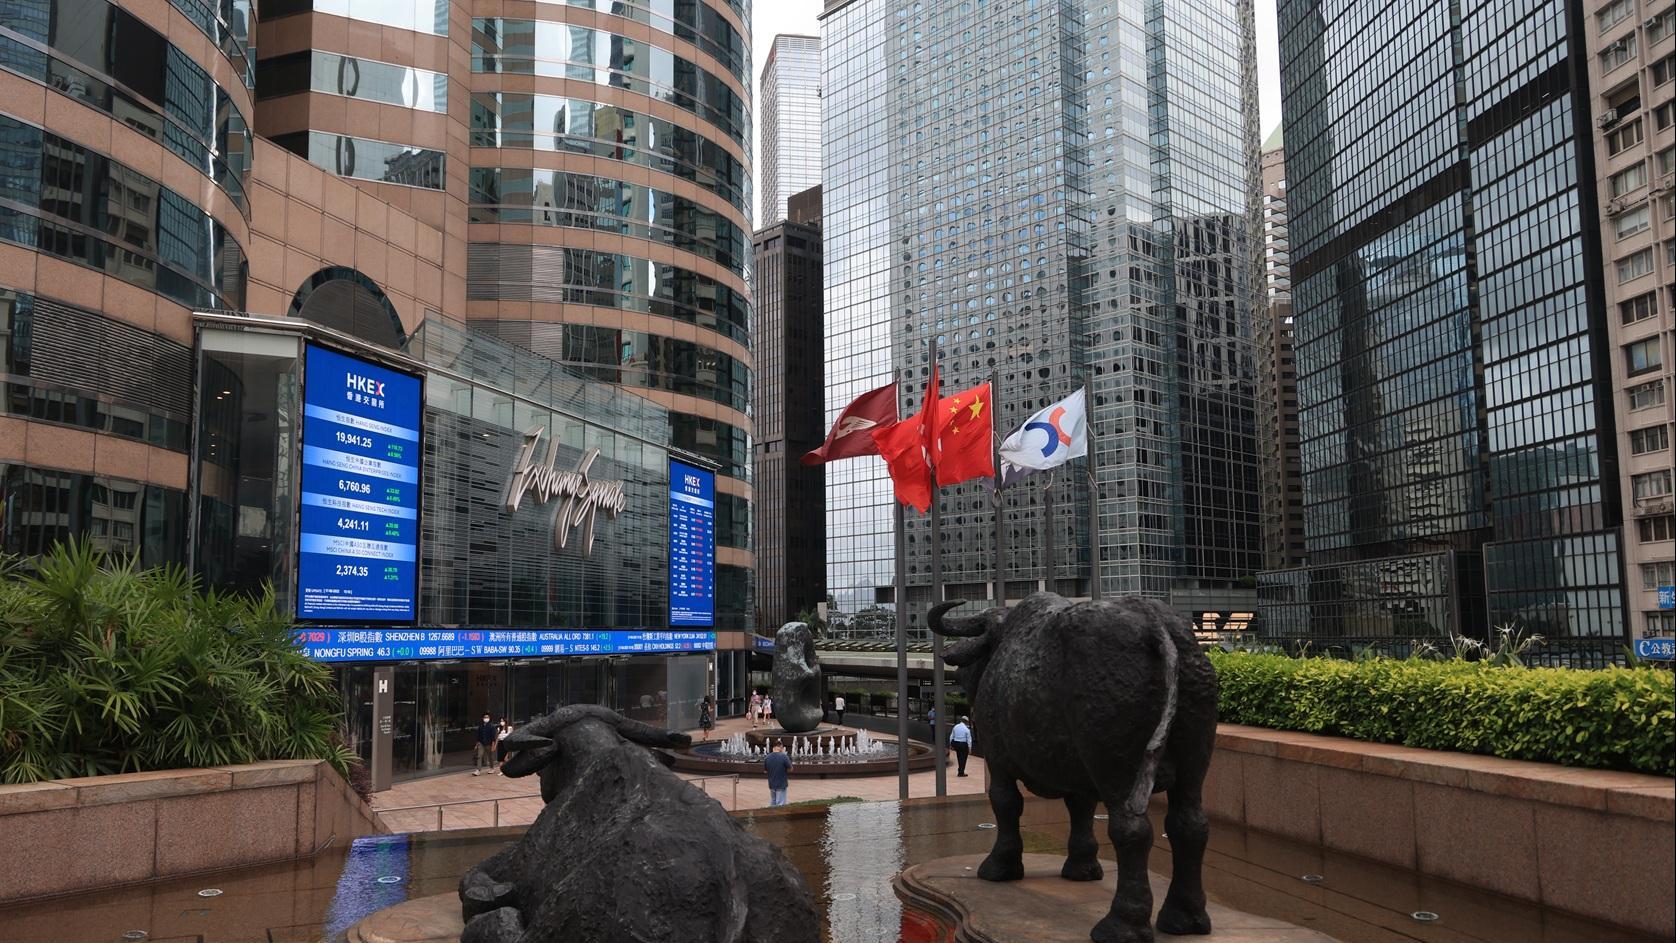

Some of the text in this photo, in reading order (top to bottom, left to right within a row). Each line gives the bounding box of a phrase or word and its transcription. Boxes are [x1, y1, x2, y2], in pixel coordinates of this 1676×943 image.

[347, 372, 385, 397] HKEX
[346, 391, 385, 409] 香港交易所
[336, 431, 373, 449] 19,941.25
[322, 459, 336, 467] HANG
[336, 461, 349, 469] SENG
[339, 479, 371, 494] 6,760.96
[338, 517, 370, 531] 4,241.11
[336, 564, 369, 577] 2,374.35
[385, 632, 419, 641] SHENZHEN
[420, 632, 426, 641] B
[539, 632, 563, 641] AUSTRALIA
[563, 632, 572, 641] ALL
[572, 632, 582, 641] ORD
[314, 648, 346, 658] NONGFU
[347, 648, 374, 657] SPRING
[377, 648, 391, 656] 46.3
[484, 645, 507, 654] BABA-SW
[379, 679, 388, 693] H
